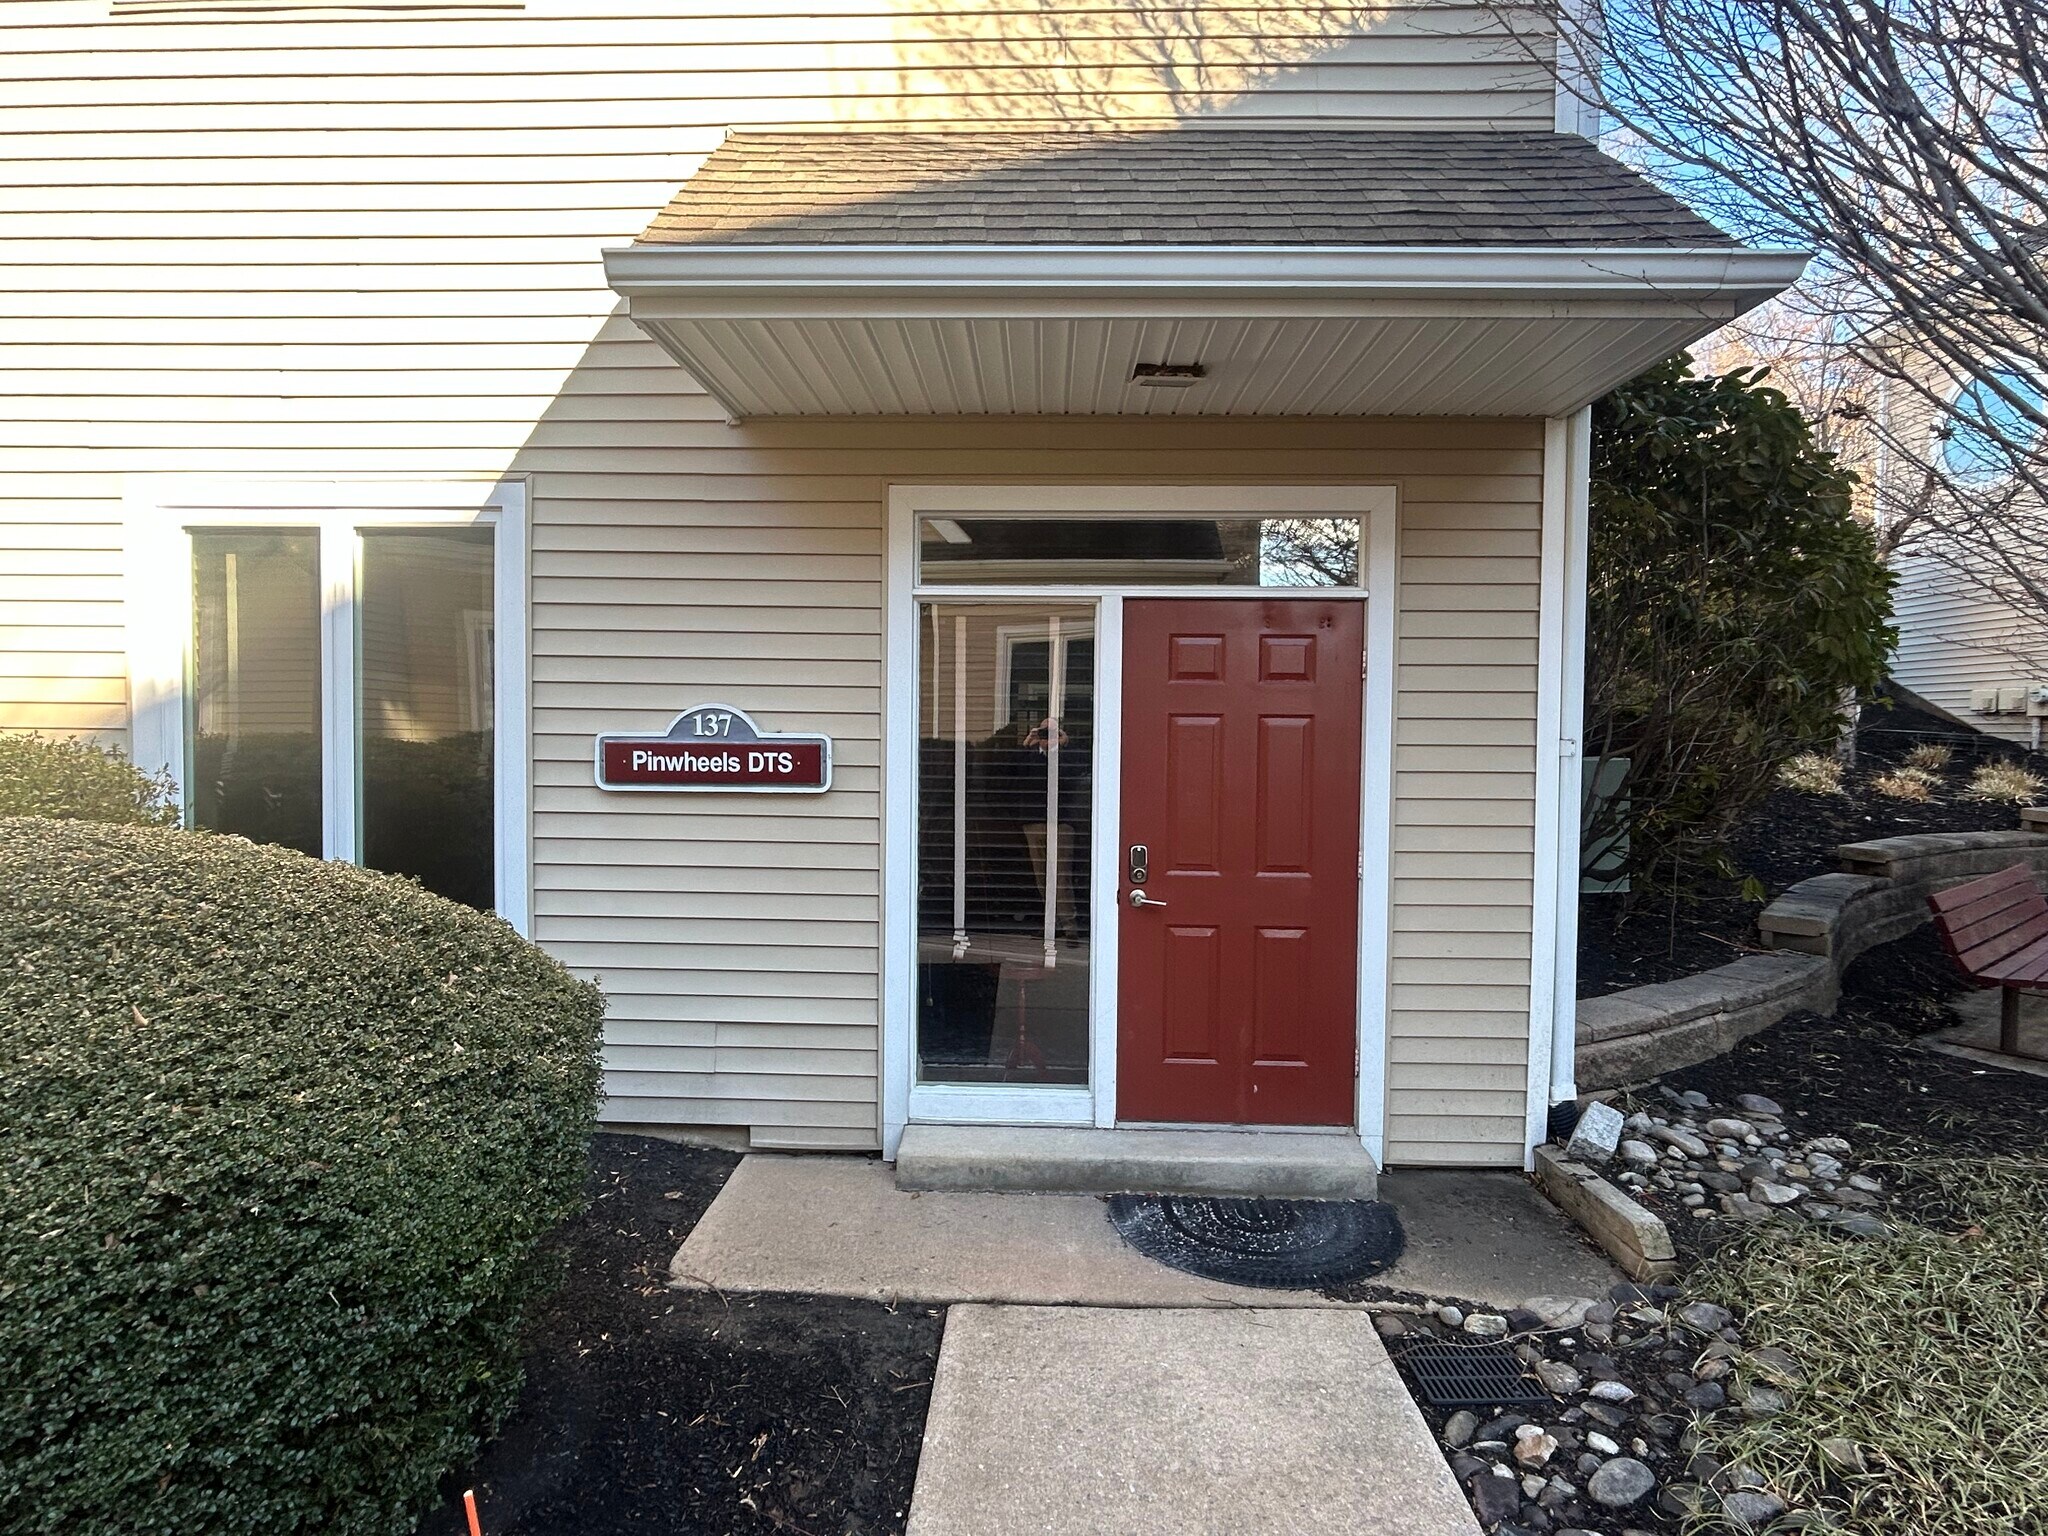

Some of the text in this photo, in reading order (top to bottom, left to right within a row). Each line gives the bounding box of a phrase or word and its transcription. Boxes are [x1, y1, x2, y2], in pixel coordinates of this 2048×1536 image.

[692, 714, 732, 737] 137
[632, 750, 793, 774] Pinwheels DTS
